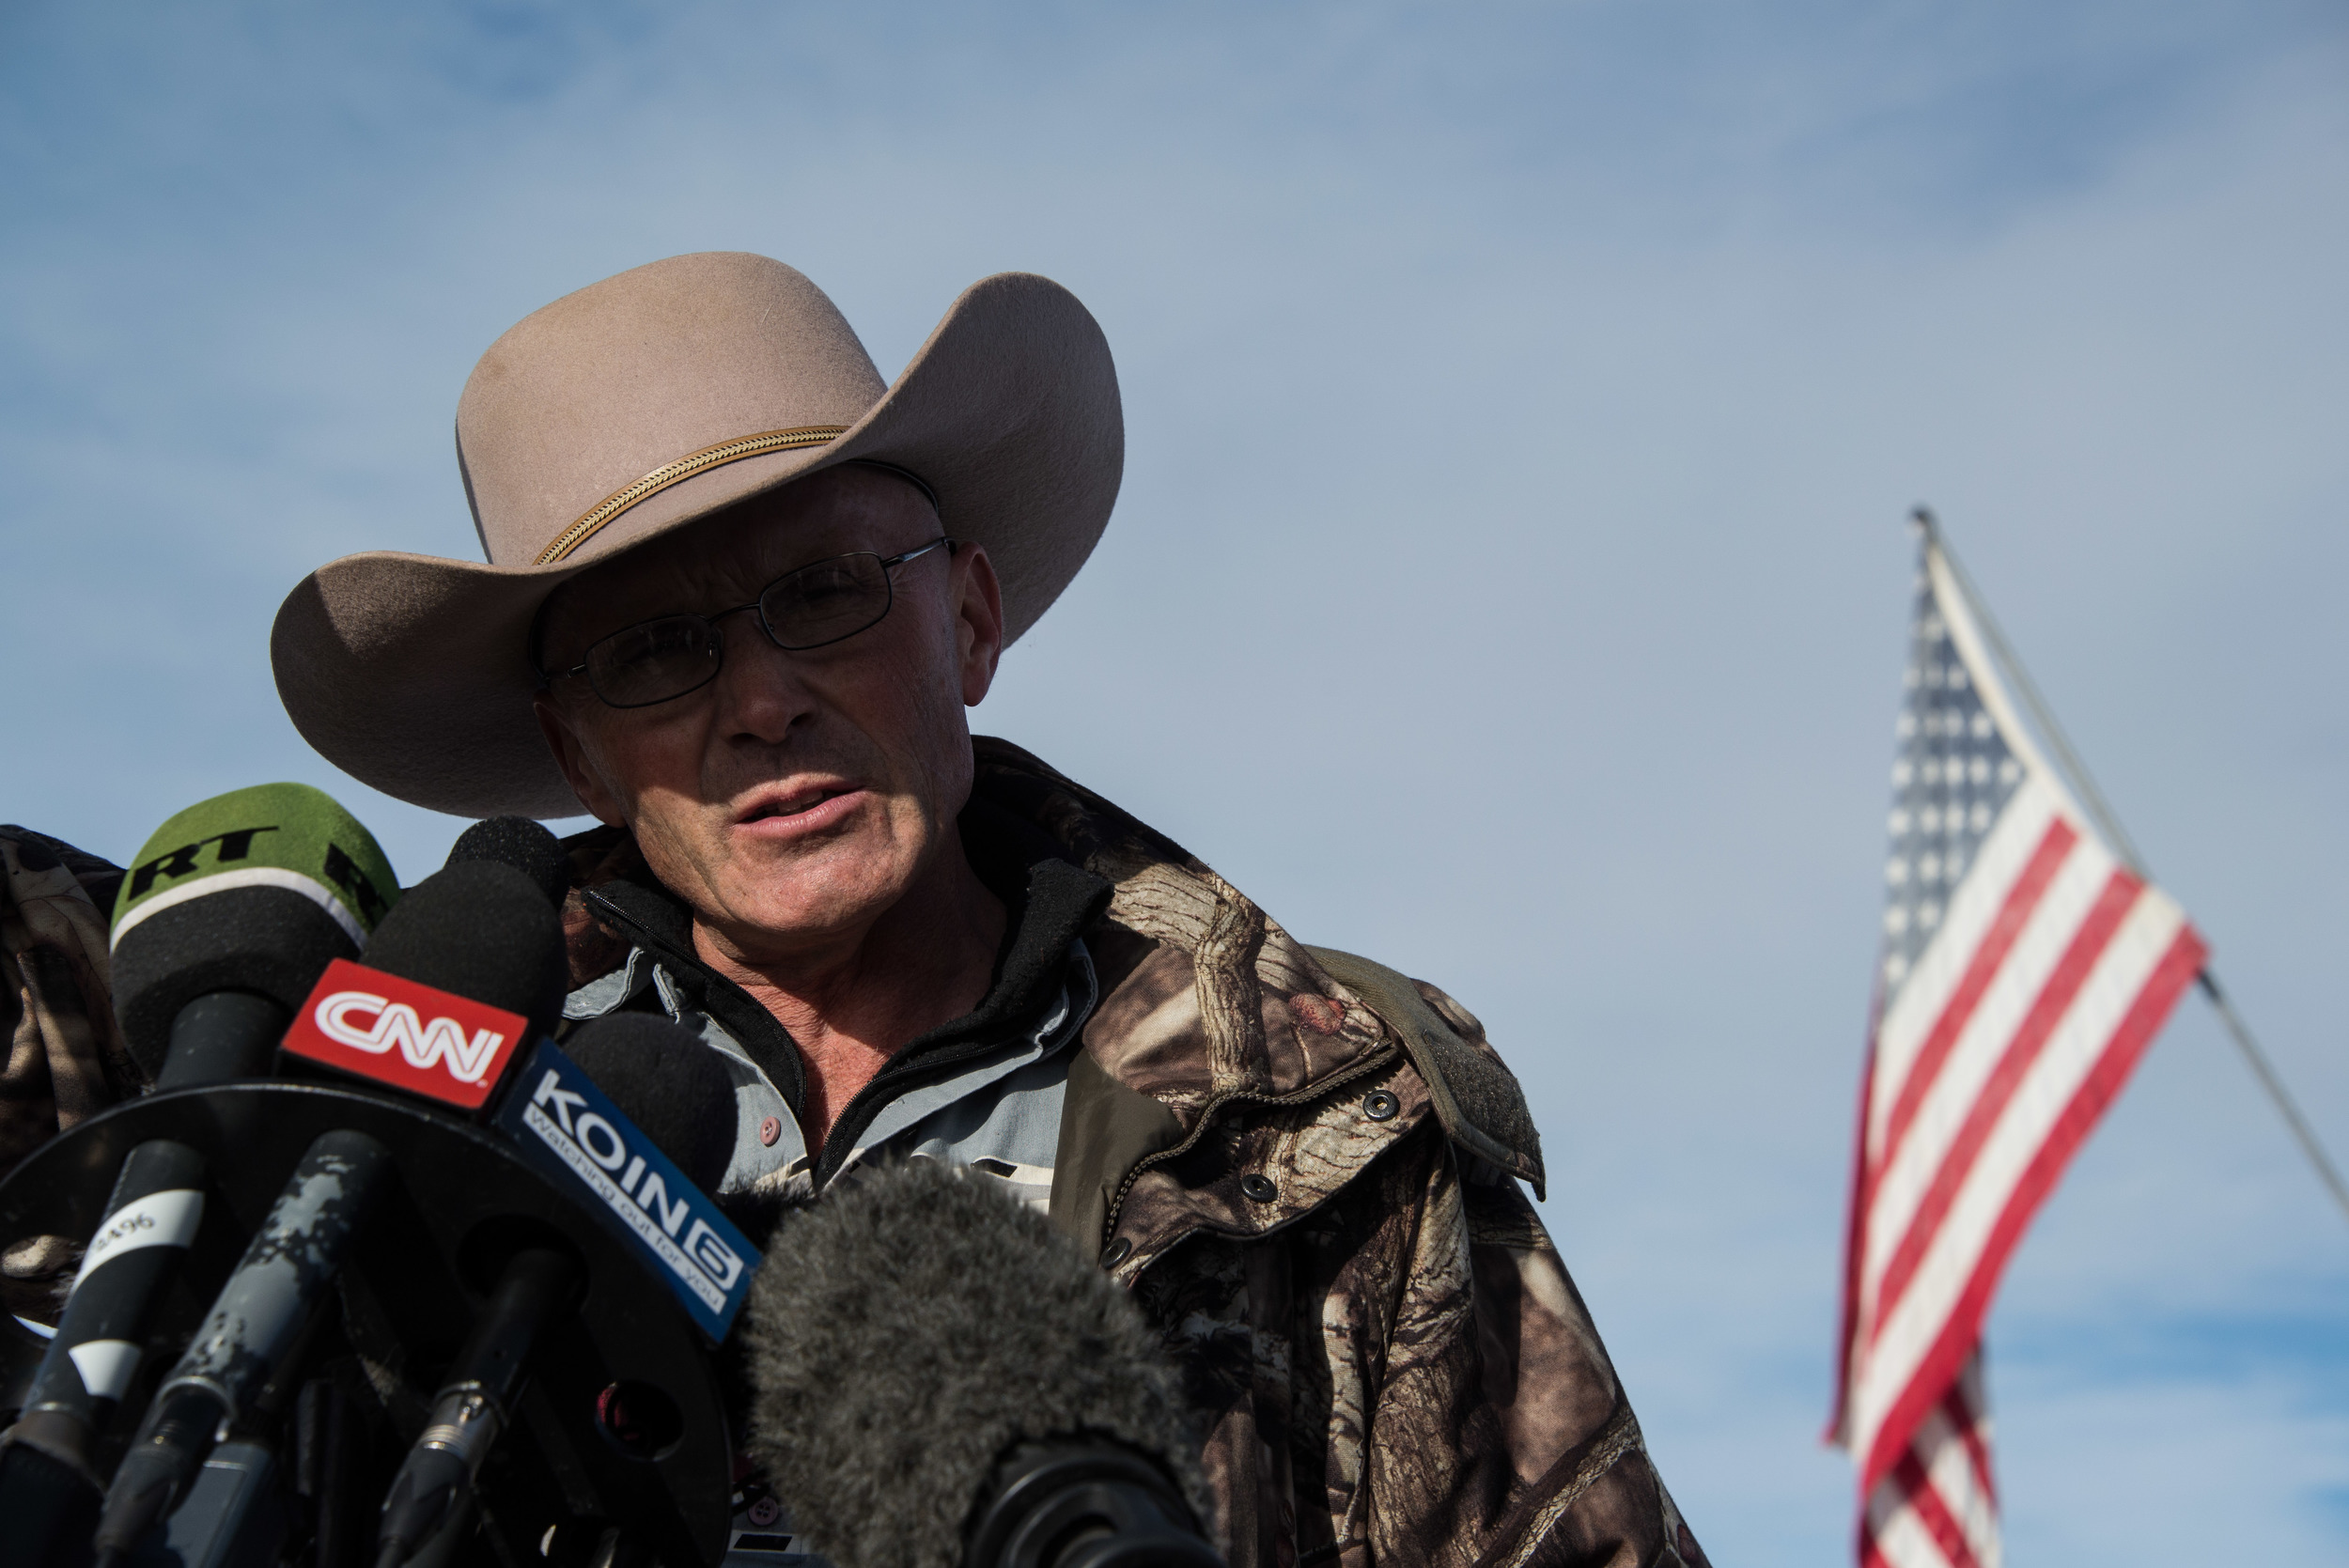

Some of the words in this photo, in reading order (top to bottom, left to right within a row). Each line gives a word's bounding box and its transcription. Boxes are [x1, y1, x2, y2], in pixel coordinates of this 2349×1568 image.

[128, 825, 279, 902] RT
[324, 843, 389, 926] R
[315, 991, 505, 1083] CNN
[530, 1108, 617, 1202] Watching
[620, 1200, 653, 1234] out
[654, 1235, 682, 1264] for
[684, 1266, 722, 1307] you
